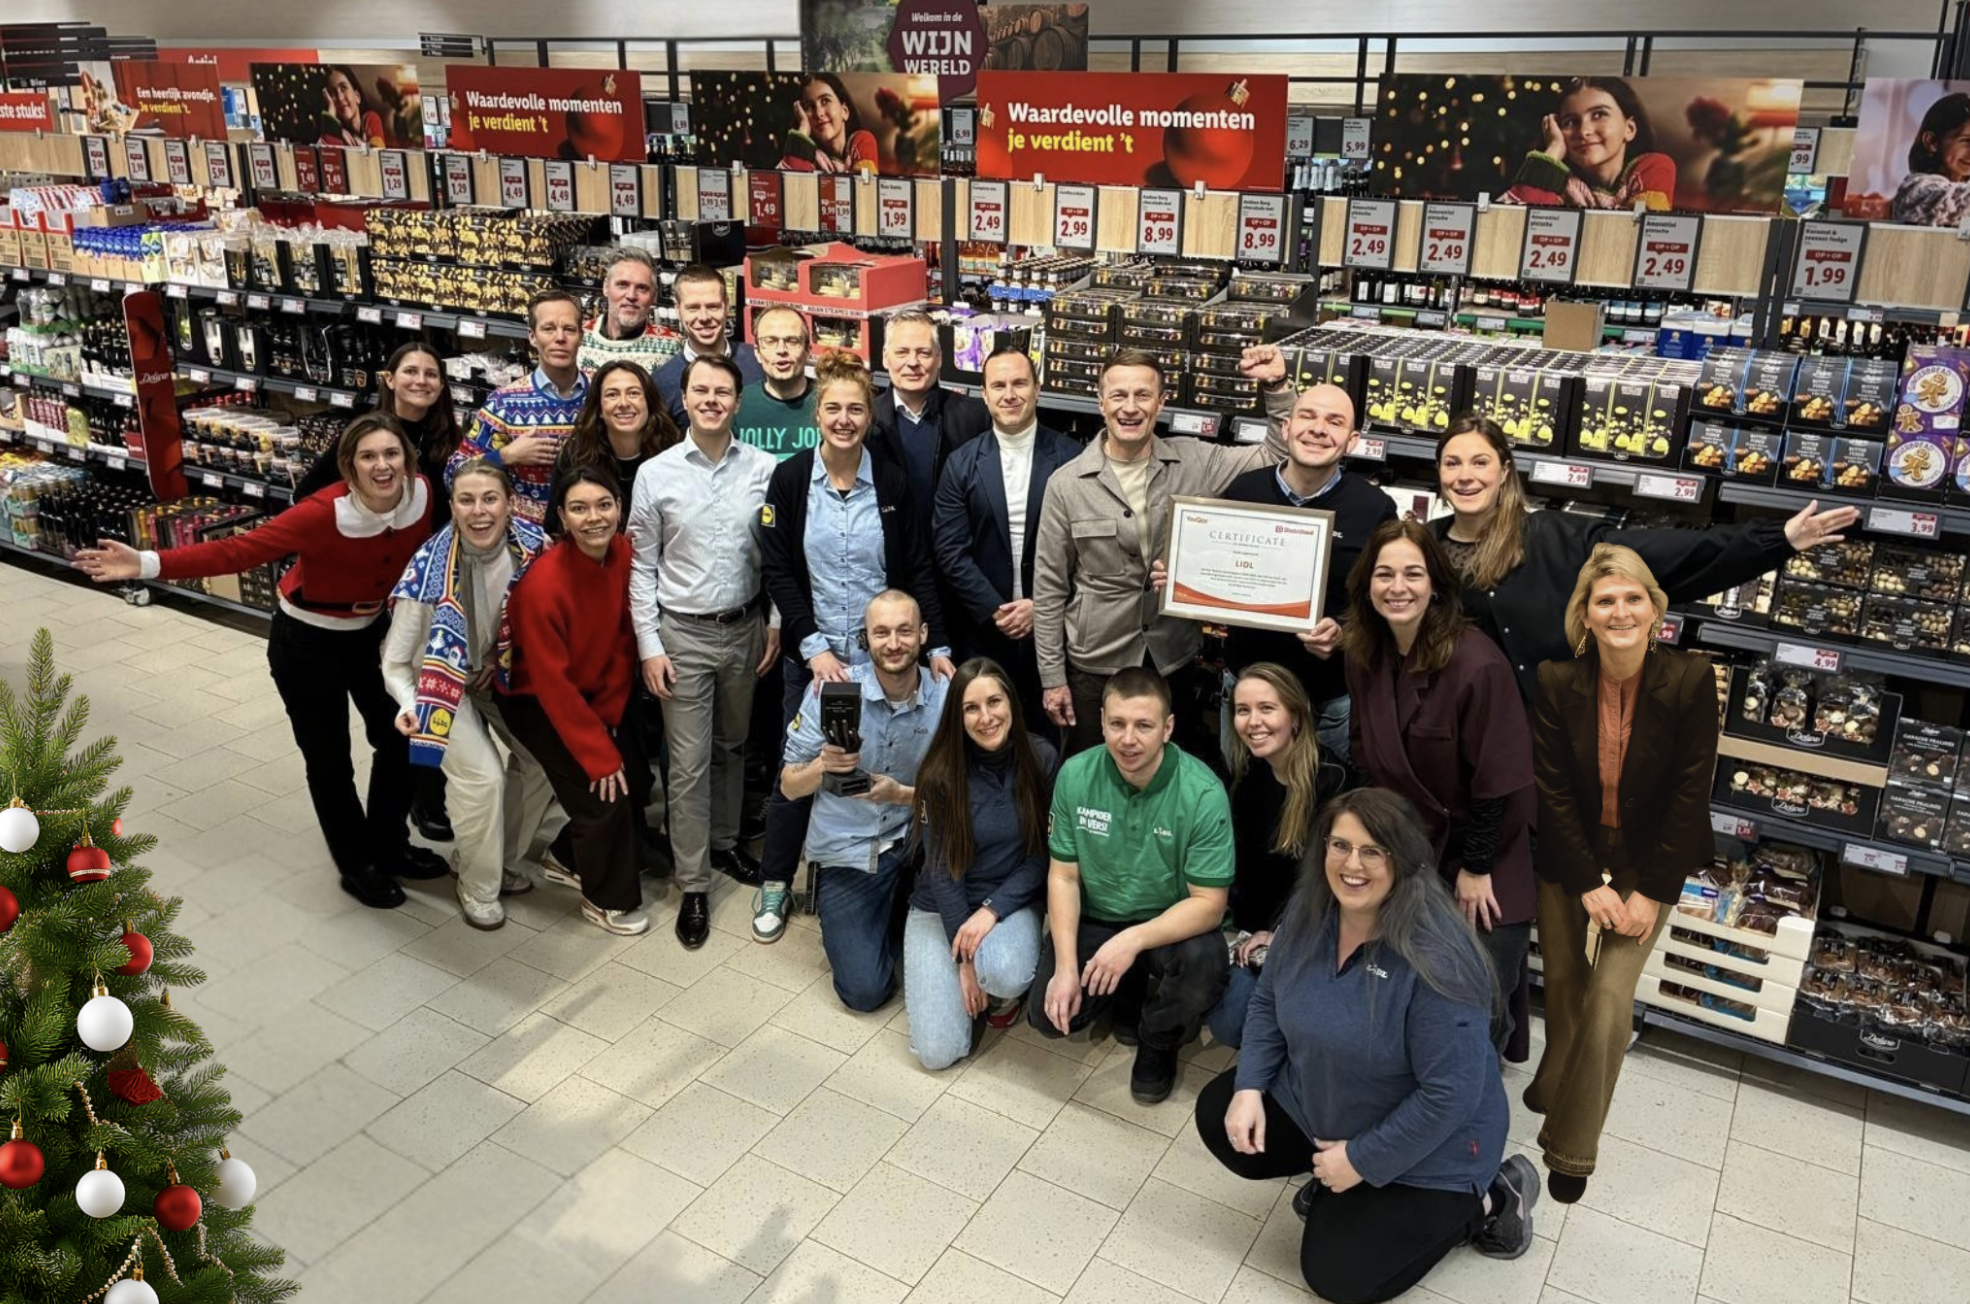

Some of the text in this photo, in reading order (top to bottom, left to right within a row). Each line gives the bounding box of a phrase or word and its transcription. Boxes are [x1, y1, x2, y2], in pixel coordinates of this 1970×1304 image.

[912, 12, 962, 22] Welkom in de
[902, 31, 972, 55] WIJN
[904, 60, 970, 75] WERELD
[136, 87, 216, 103] Een heerlijk avondje.
[466, 91, 622, 114] Waardevolle momenten
[16, 102, 46, 119] stuks!
[138, 101, 148, 112] Je
[150, 102, 182, 114] verdient
[468, 111, 480, 132] je
[482, 114, 536, 132] verdient
[1008, 104, 1254, 130] Waardevolle momenten
[1008, 128, 1025, 153] je
[1030, 130, 1114, 152] verdient
[1346, 142, 1366, 152] 5.99
[1791, 153, 1810, 166] .99
[756, 202, 776, 216] 1.49
[884, 212, 906, 227] 1.99
[976, 214, 1000, 232] 2.49
[1061, 220, 1088, 237] 2.99
[1144, 226, 1173, 242] 8.99
[1244, 232, 1275, 249] 8.99
[1352, 238, 1385, 256] 2.49
[1428, 244, 1462, 261] 2.49
[1530, 250, 1567, 268] 2.49
[1644, 258, 1684, 276] 2.49
[1805, 266, 1846, 286] 1.99
[139, 372, 170, 384] Deluxe
[1908, 366, 1951, 391] GINGERBREAD
[1568, 474, 1586, 483] 2.99
[1674, 488, 1695, 497] 2.99
[1910, 522, 1934, 533] 3.99
[1209, 530, 1286, 547] CERTIFICATE
[1235, 560, 1254, 569] LIDL
[1814, 658, 1836, 669] 4.99
[1790, 731, 1822, 744] Deluxe
[1775, 801, 1806, 814] Deluxe
[1866, 1032, 1898, 1048] Deluxe
